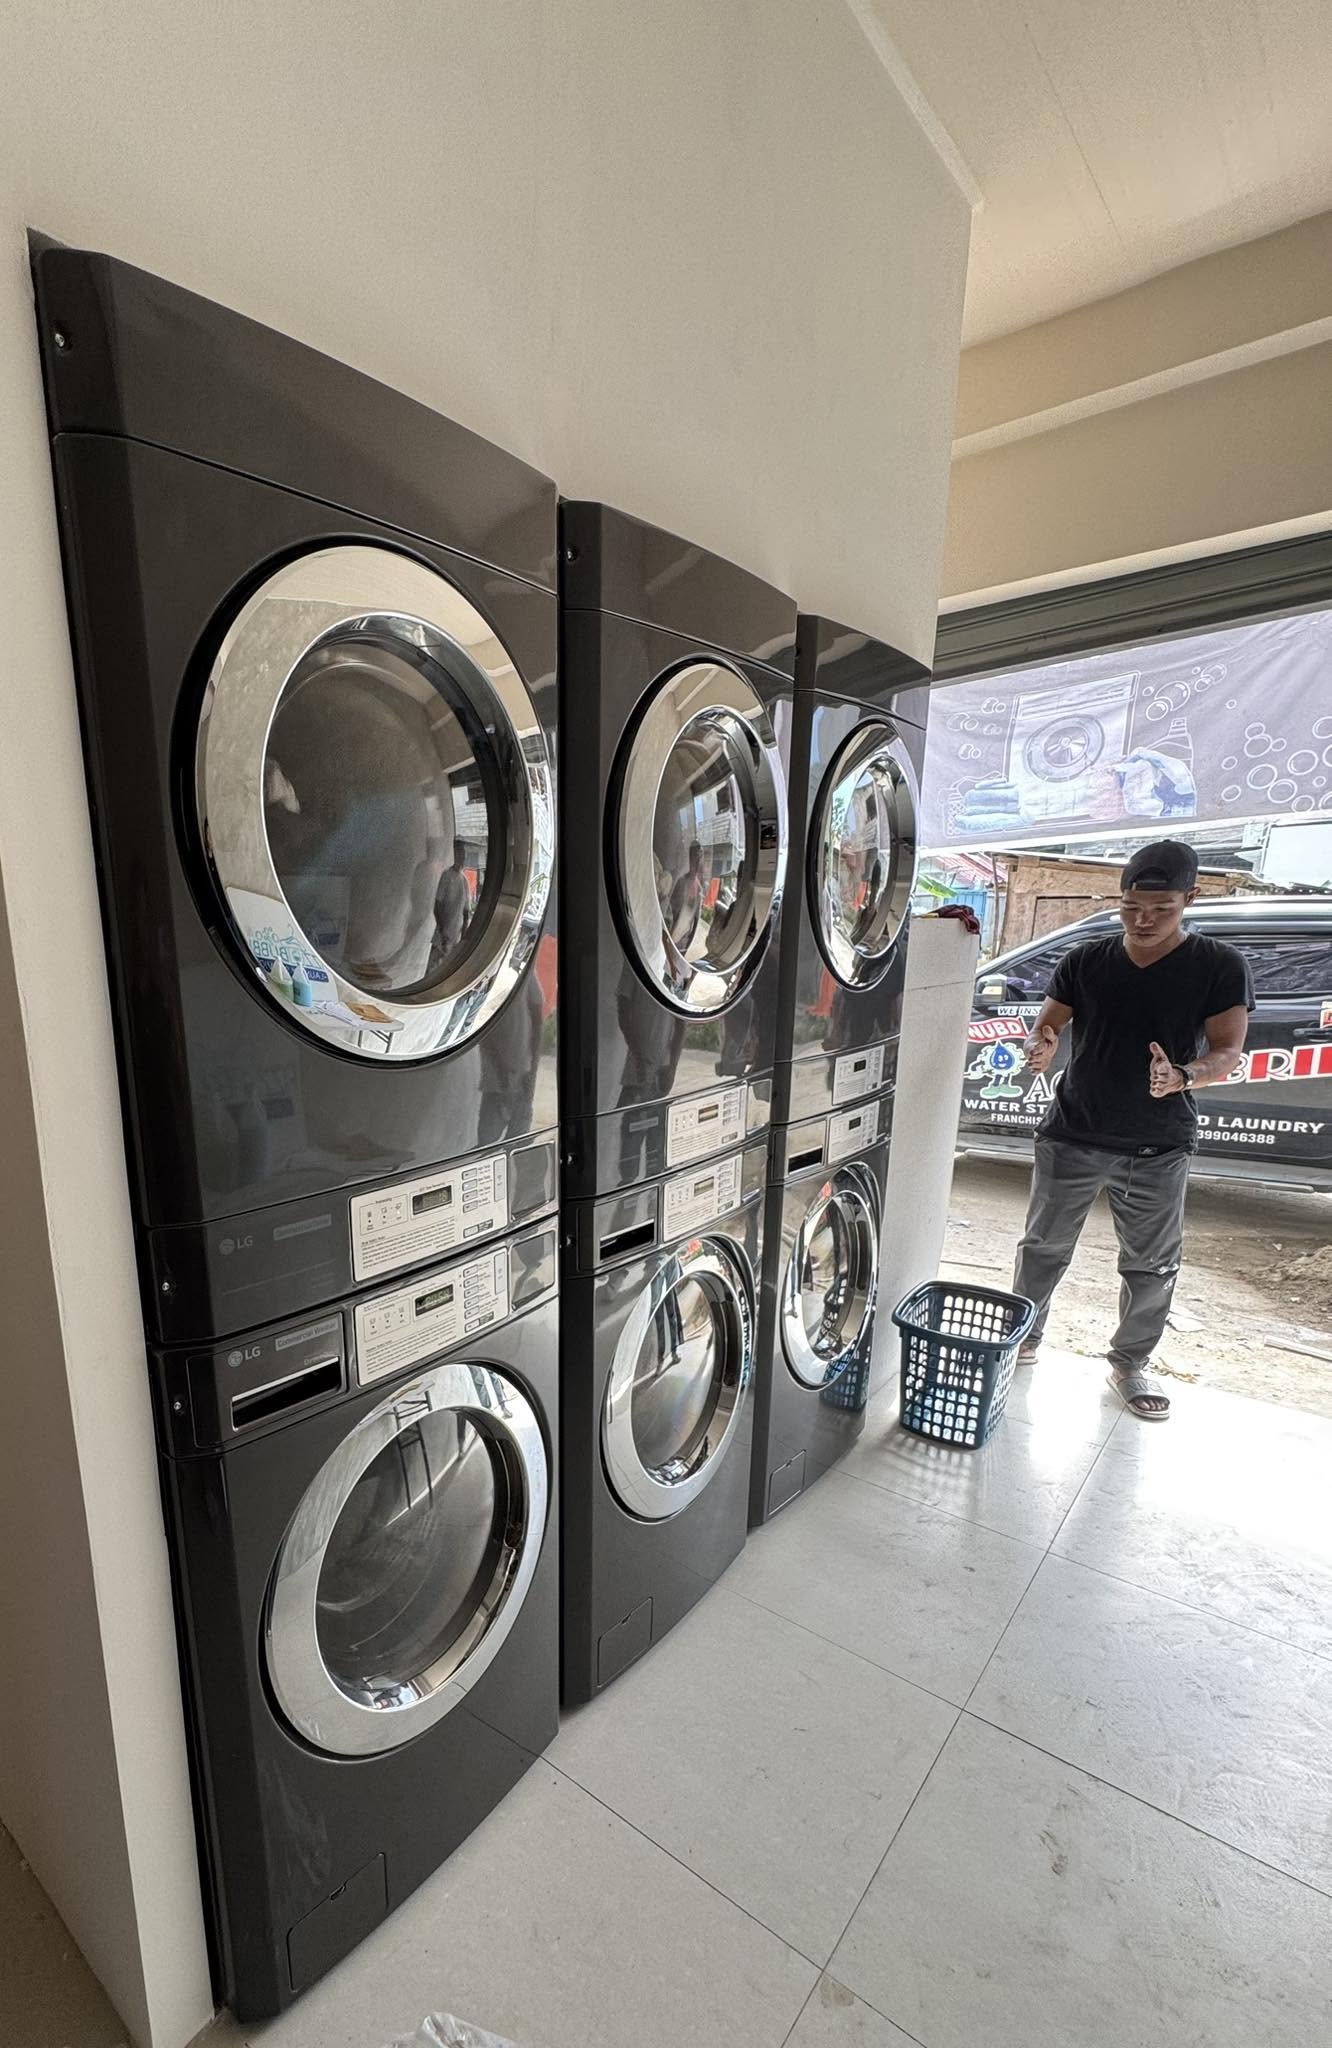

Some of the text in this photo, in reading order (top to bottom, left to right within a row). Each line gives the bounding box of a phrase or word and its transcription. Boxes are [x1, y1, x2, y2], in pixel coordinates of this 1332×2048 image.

[999, 1006, 1017, 1015] WE
[964, 1099, 1020, 1113] WATER
[1218, 1116, 1325, 1134] LAUNDRY
[237, 1235, 254, 1249] LG
[244, 1346, 262, 1361] LG
